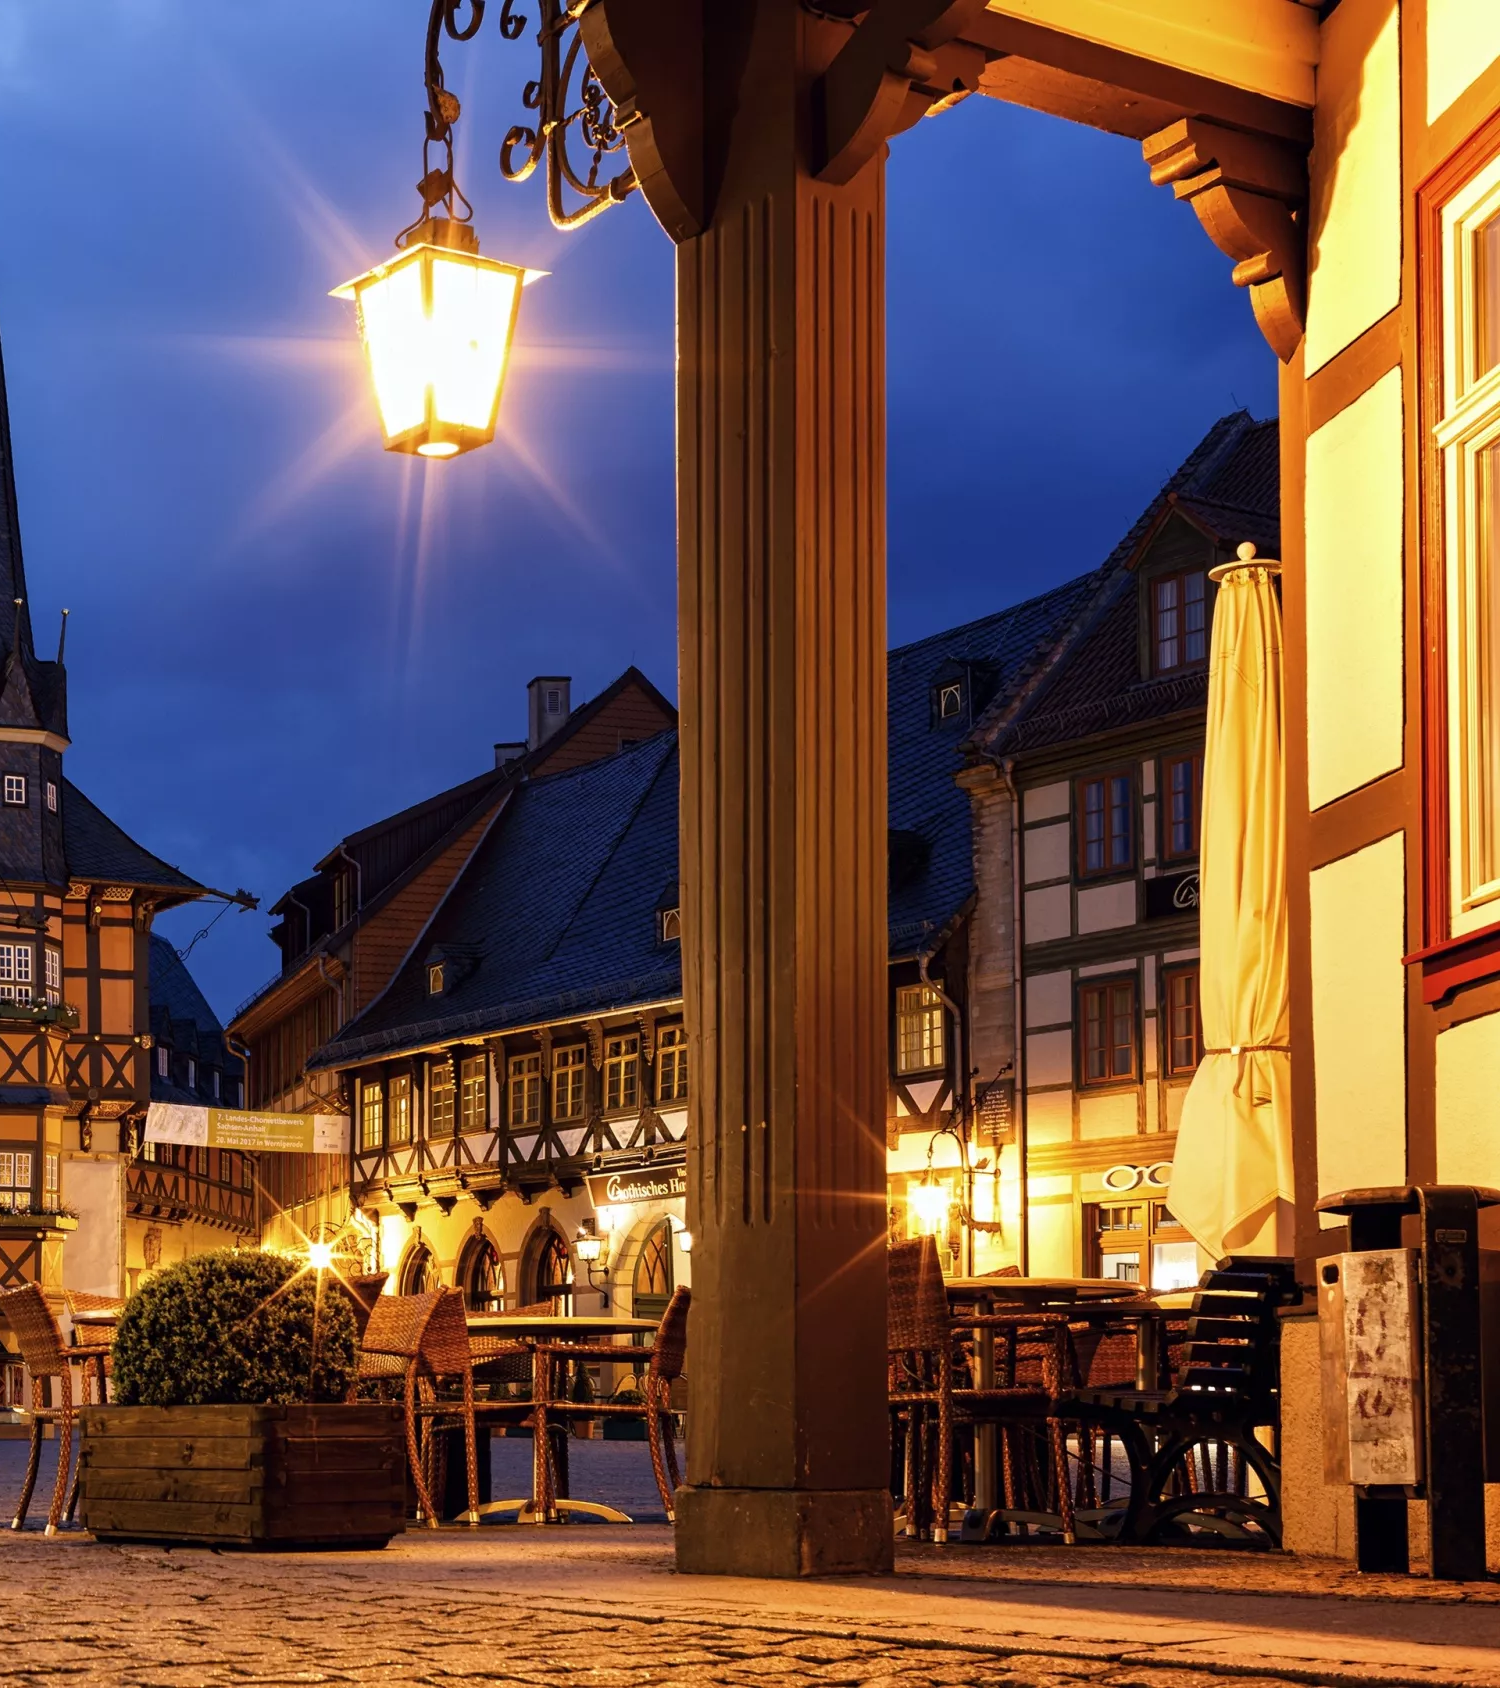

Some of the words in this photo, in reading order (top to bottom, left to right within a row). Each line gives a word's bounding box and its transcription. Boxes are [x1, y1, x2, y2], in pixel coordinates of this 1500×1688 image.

[217, 1113, 224, 1121] 7.
[217, 1122, 266, 1132] Sachsen-Anhalt
[216, 1136, 226, 1144] 20.
[227, 1137, 239, 1145] Mai
[240, 1138, 256, 1146] 2017
[264, 1140, 303, 1148] Wernigerode
[606, 1175, 669, 1201] Gothisches
[669, 1177, 686, 1193] Ha
